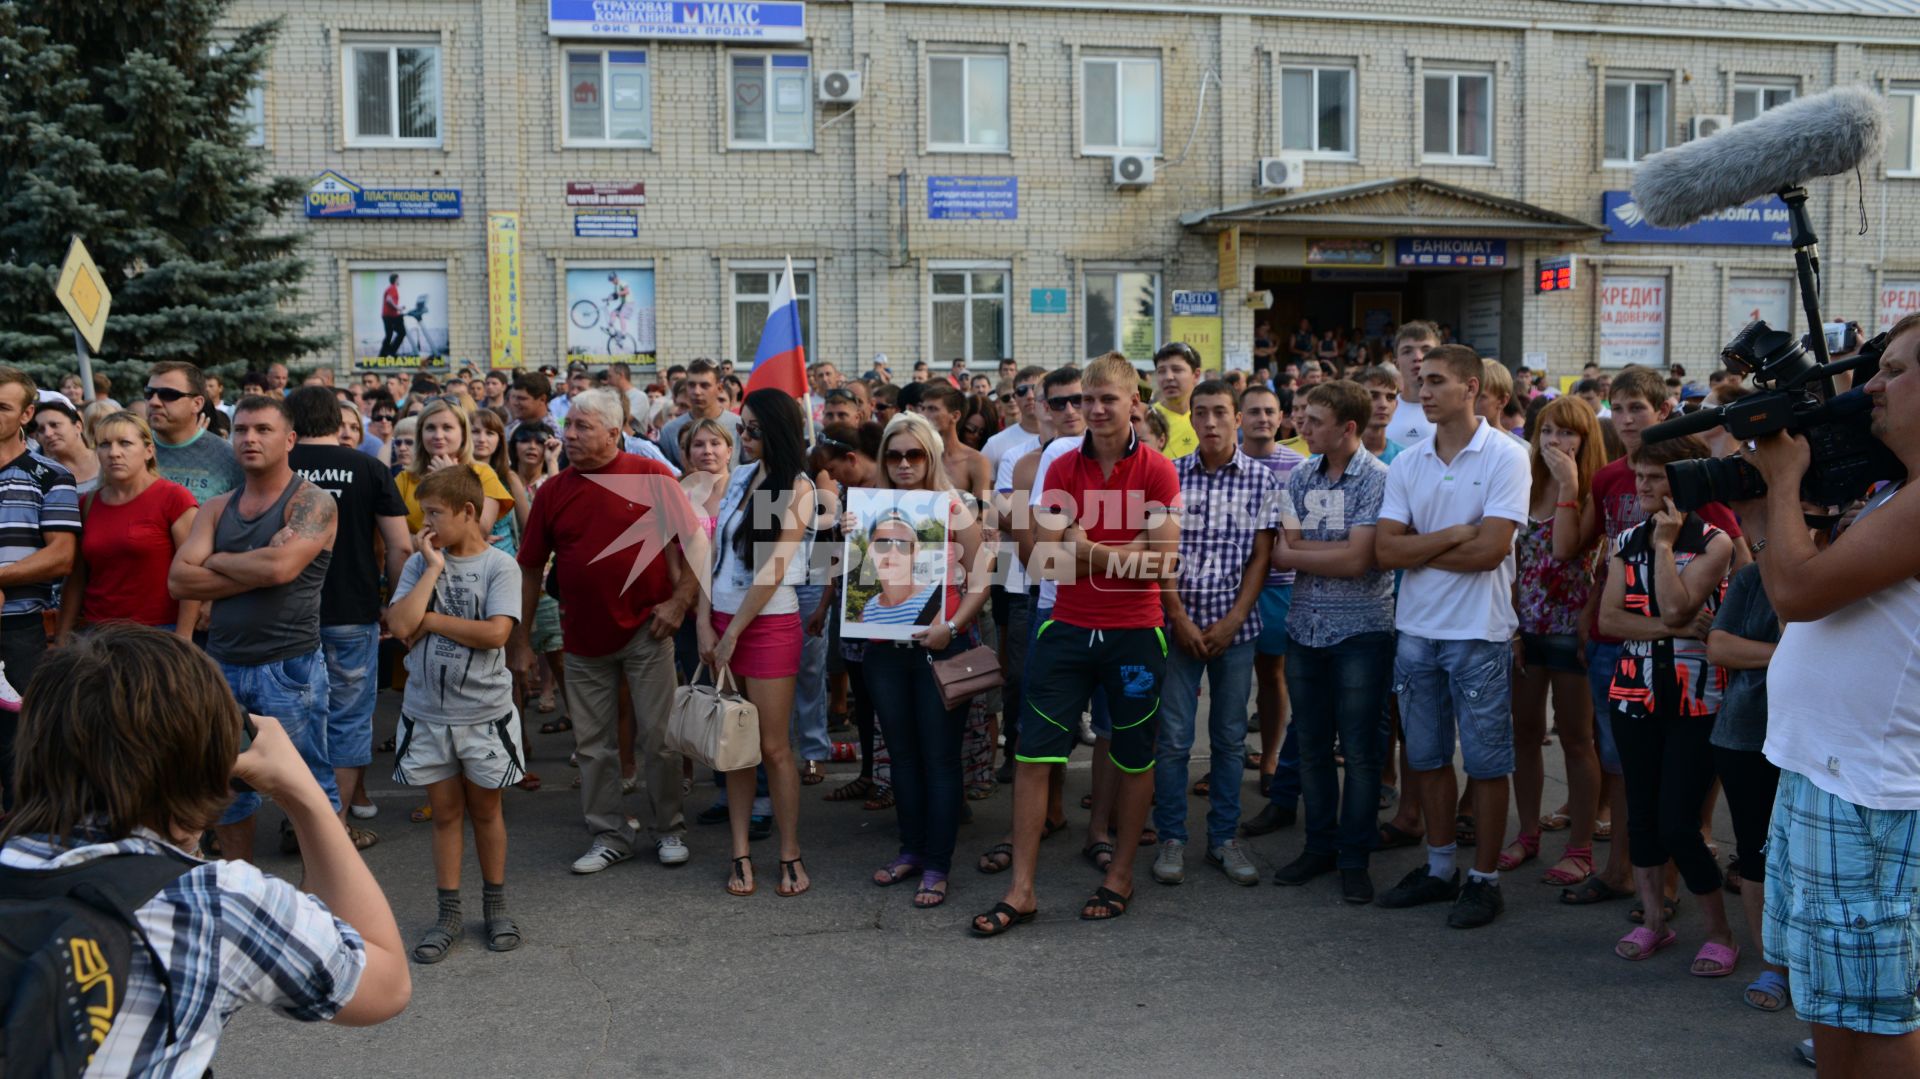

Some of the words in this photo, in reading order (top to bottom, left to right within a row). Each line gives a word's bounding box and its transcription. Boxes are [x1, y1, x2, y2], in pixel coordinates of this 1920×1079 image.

[592, 1, 673, 12] СТРАХОВАЯ
[595, 10, 673, 23] КОМПАНИЯ
[703, 4, 760, 25] МАКС
[592, 24, 630, 33] ОФИС
[639, 25, 698, 35] ПРЯМЫХ
[705, 26, 764, 36] ПРОДАЖ
[310, 191, 350, 206] ОКНА
[363, 191, 430, 202] ПЛАСТИКОВЫЕ
[432, 191, 457, 202] ОКНА
[1763, 208, 1790, 222] БАН
[1412, 240, 1494, 253] БАНКОМАТ
[1600, 287, 1662, 309] КРЕДИТ
[1616, 311, 1663, 325] ДОВЕРИИ
